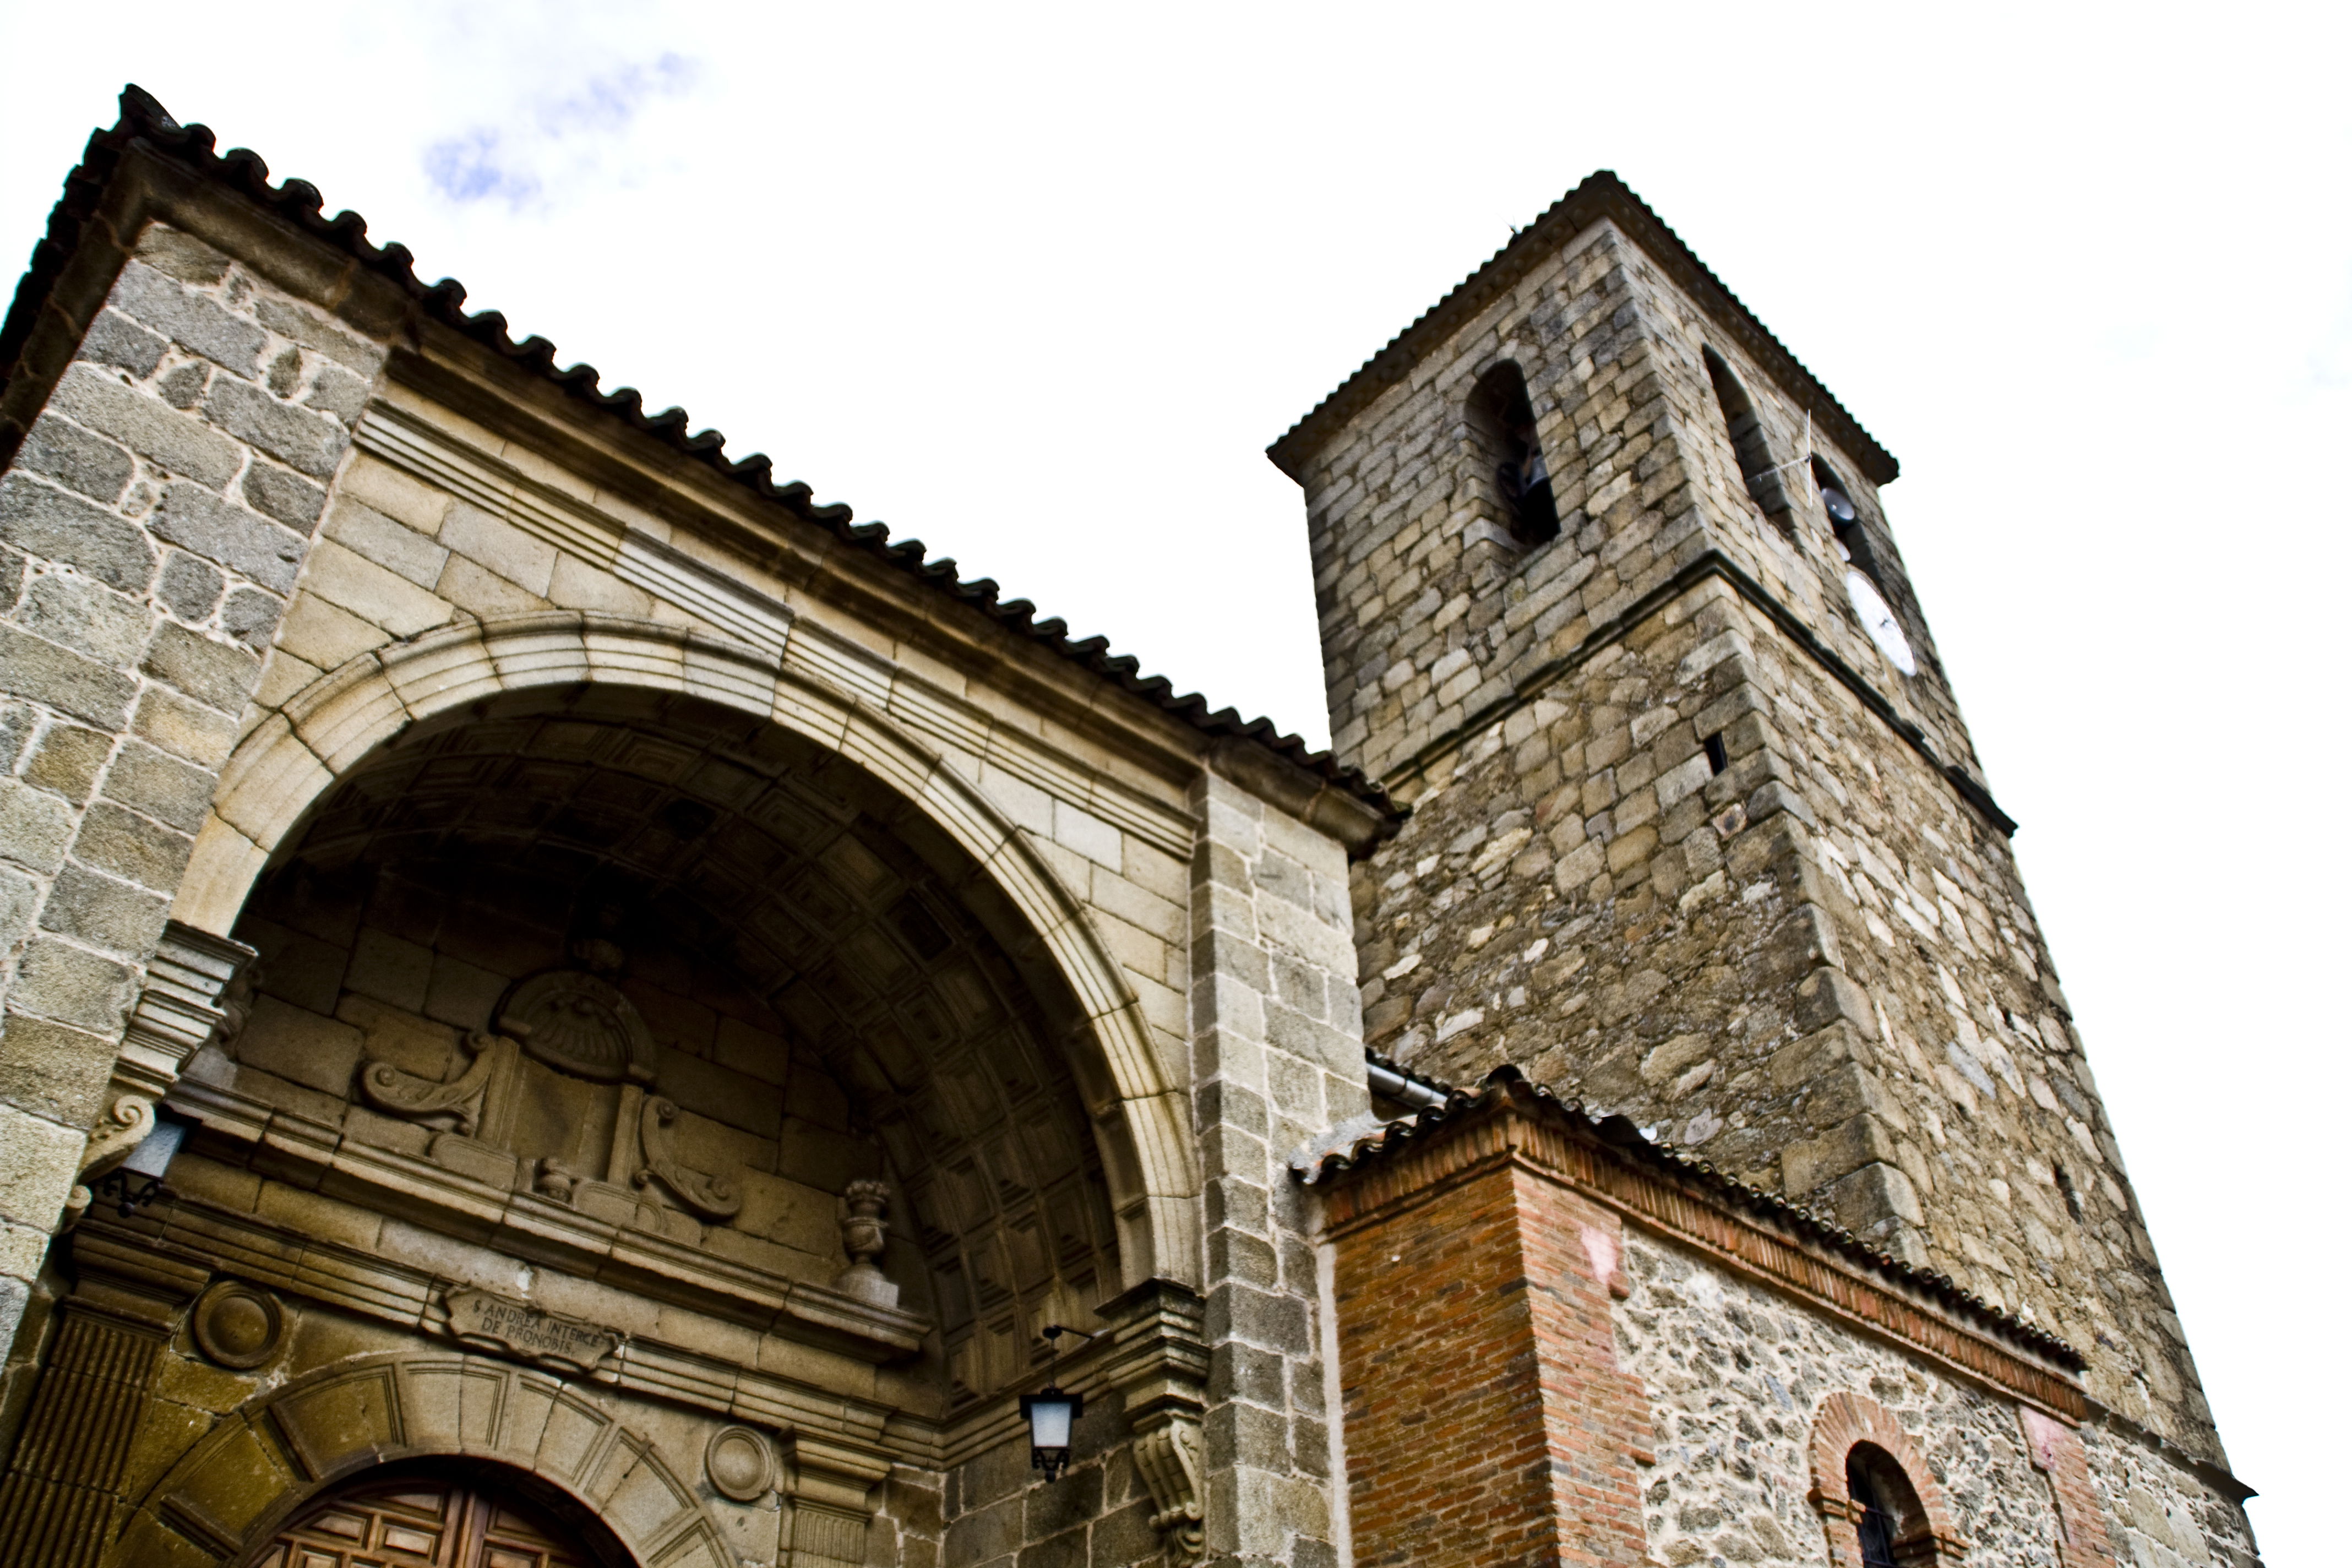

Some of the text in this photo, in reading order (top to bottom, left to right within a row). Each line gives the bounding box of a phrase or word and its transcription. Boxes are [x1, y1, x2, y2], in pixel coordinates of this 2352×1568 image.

[481, 1317, 502, 1335] DE
[484, 1304, 541, 1330] ANDREA
[547, 1321, 600, 1347] INTERCE
